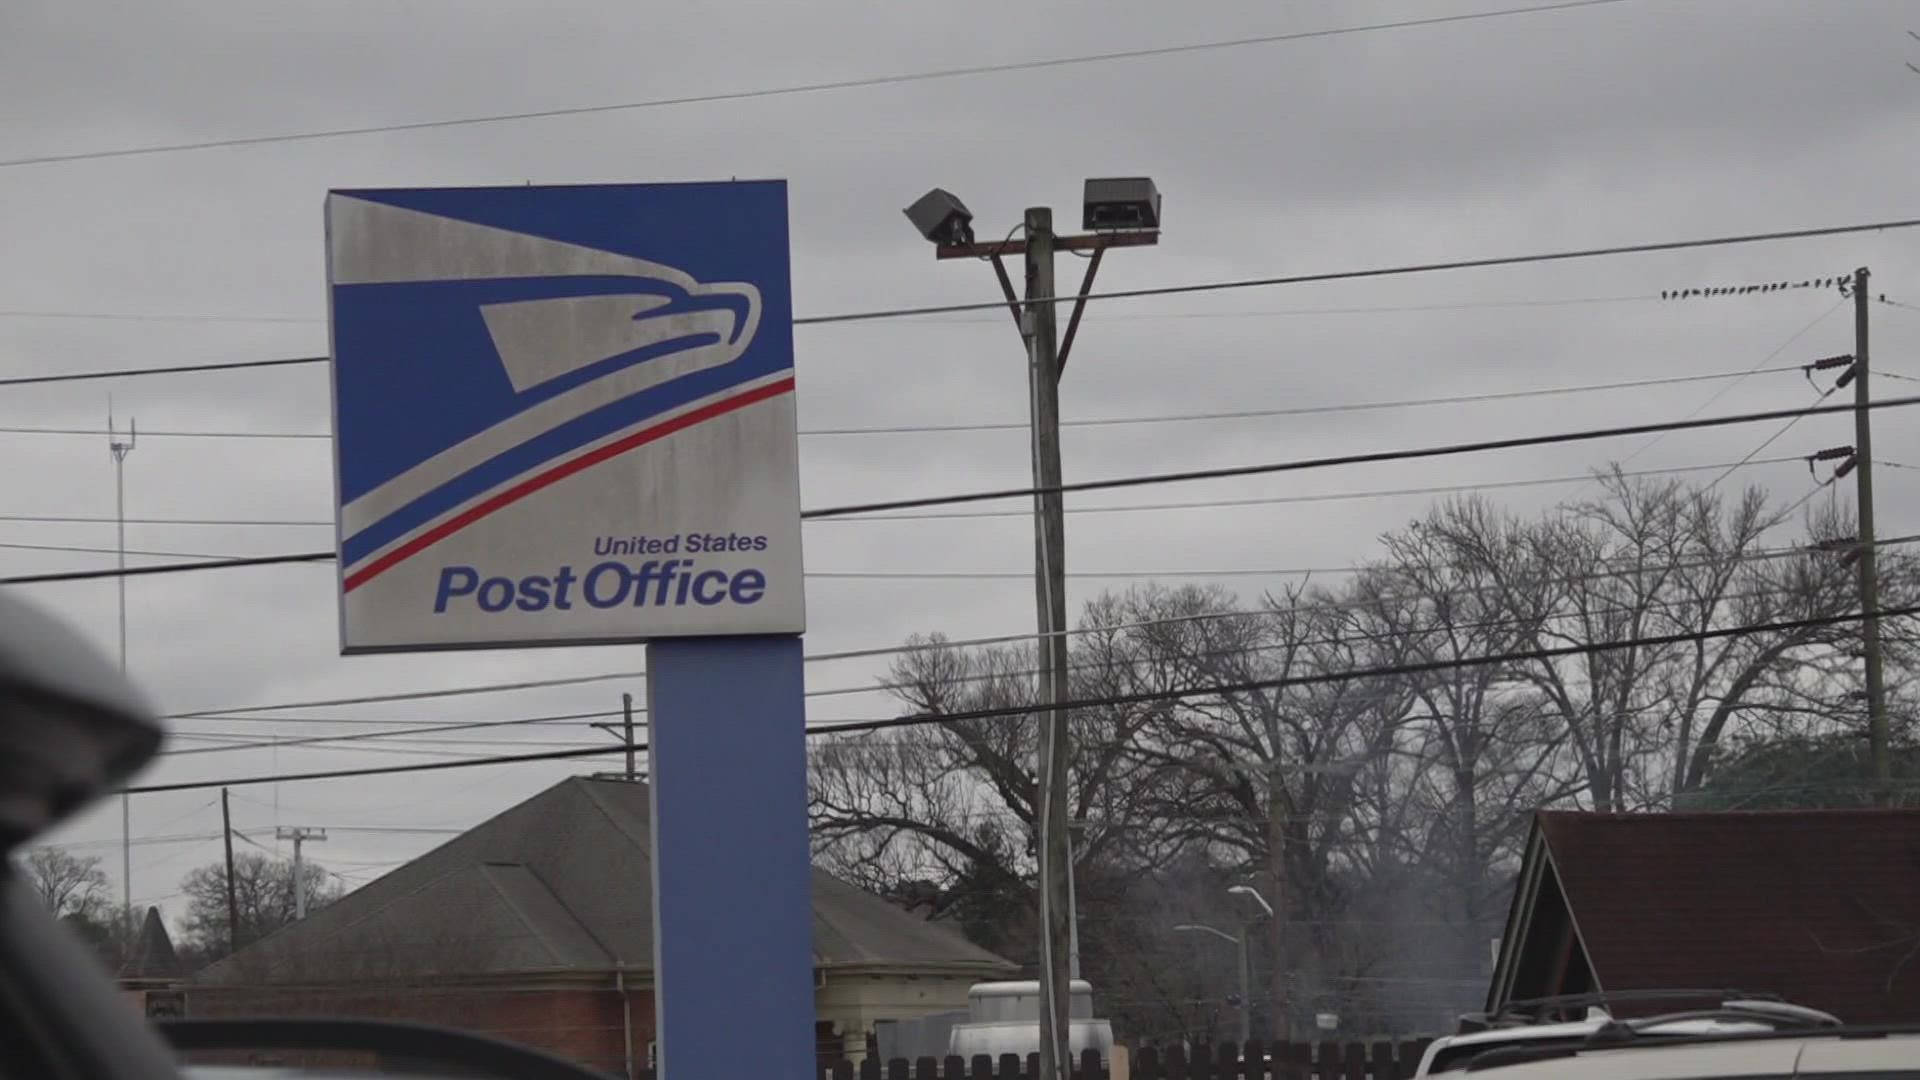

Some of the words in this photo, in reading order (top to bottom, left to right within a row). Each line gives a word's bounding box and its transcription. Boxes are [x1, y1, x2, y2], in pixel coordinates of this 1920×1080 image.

[594, 534, 679, 556] United
[684, 532, 768, 552] States
[433, 566, 577, 613] Post
[583, 559, 766, 610] Office
